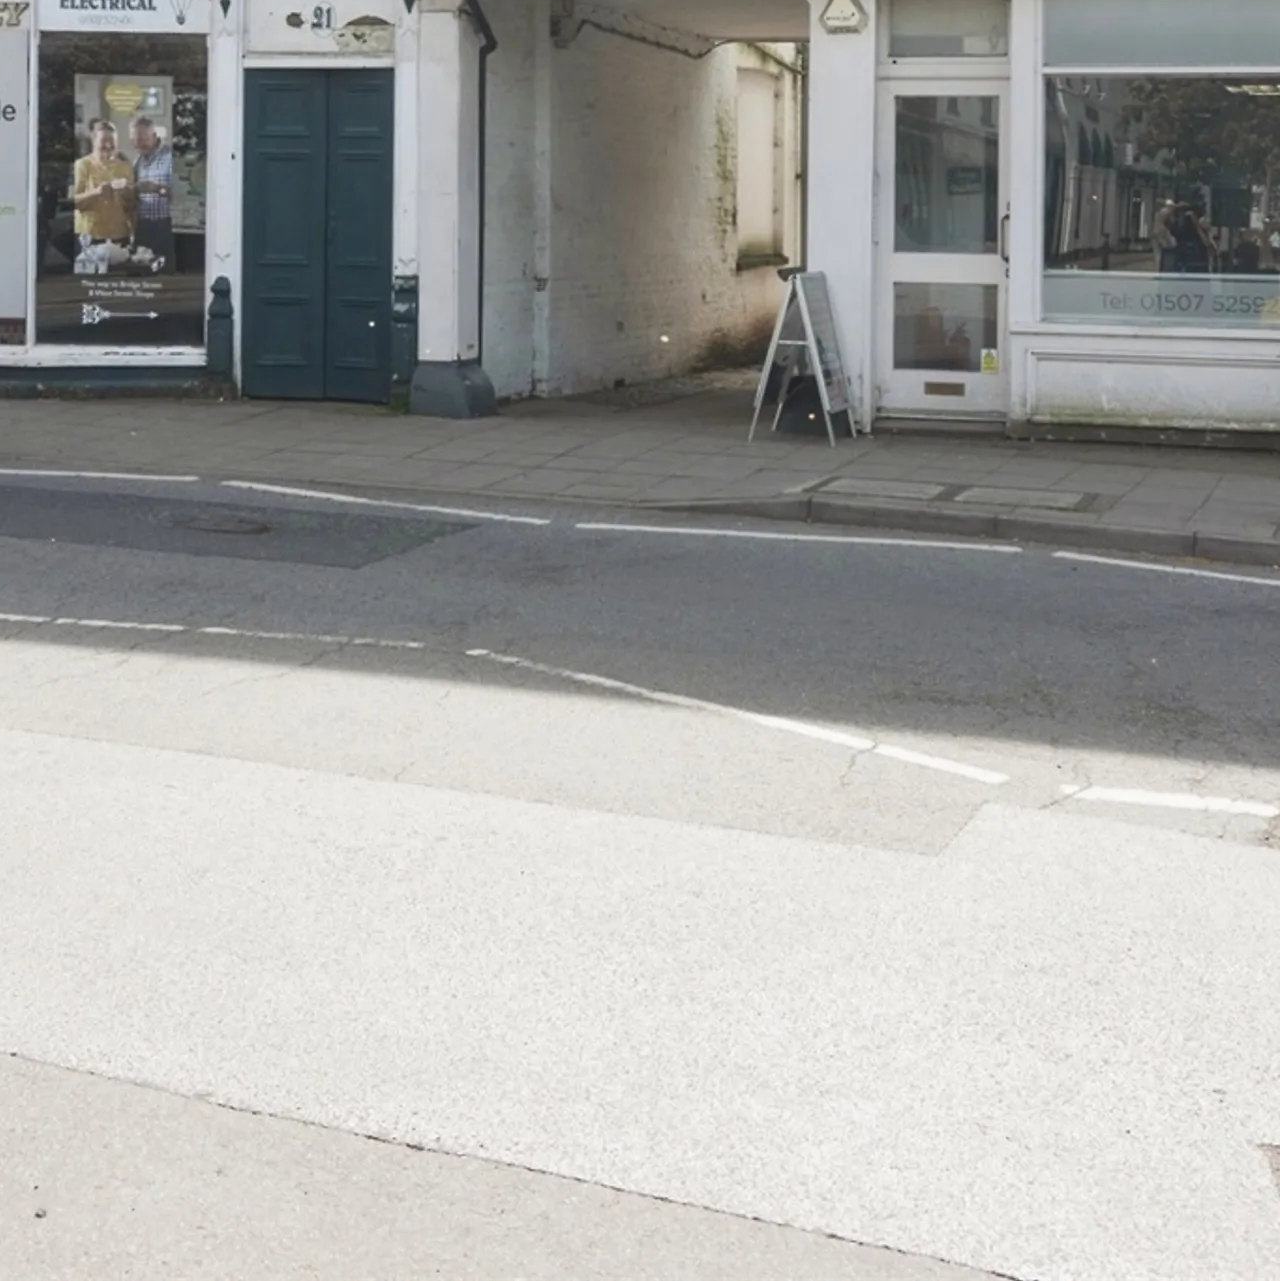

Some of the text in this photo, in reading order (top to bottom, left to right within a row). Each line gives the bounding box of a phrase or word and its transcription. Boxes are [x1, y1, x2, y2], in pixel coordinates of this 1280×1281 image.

[311, 6, 332, 30] 21
[1099, 291, 1133, 311] Tel:
[1140, 294, 1204, 313] 01507
